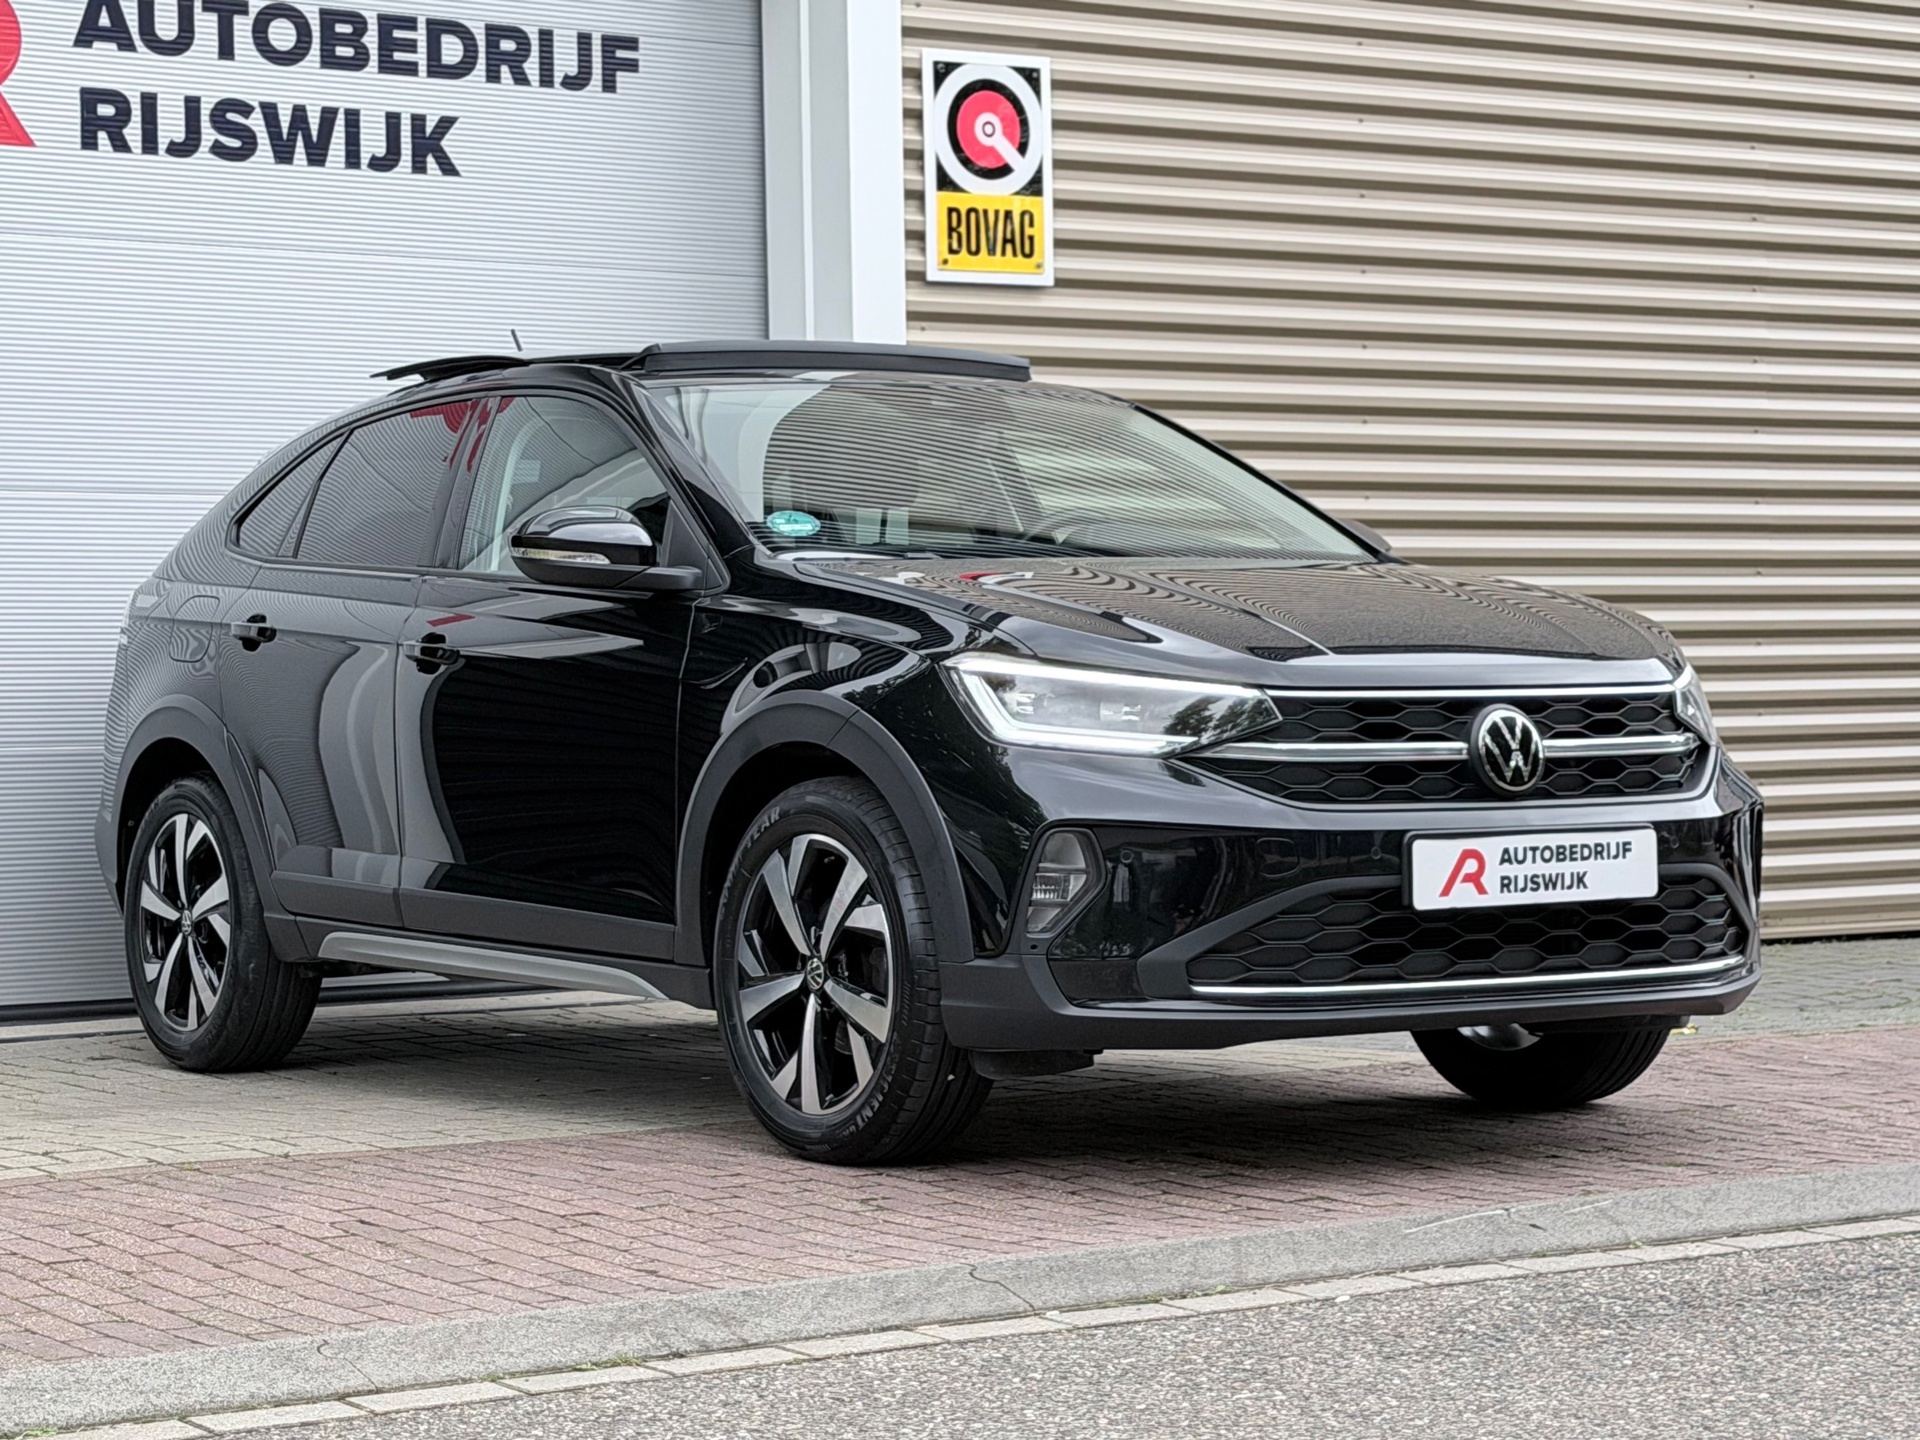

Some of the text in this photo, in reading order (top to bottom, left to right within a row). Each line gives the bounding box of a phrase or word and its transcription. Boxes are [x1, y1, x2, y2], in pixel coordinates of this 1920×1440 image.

[73, 0, 640, 93] AUTOBEDRIJF
[79, 86, 463, 177] RIJSWIJK
[946, 206, 1036, 259] BOVAG
[1498, 841, 1633, 866] AUTOBEDRIJF
[1499, 871, 1589, 894] RIJSWIJK
